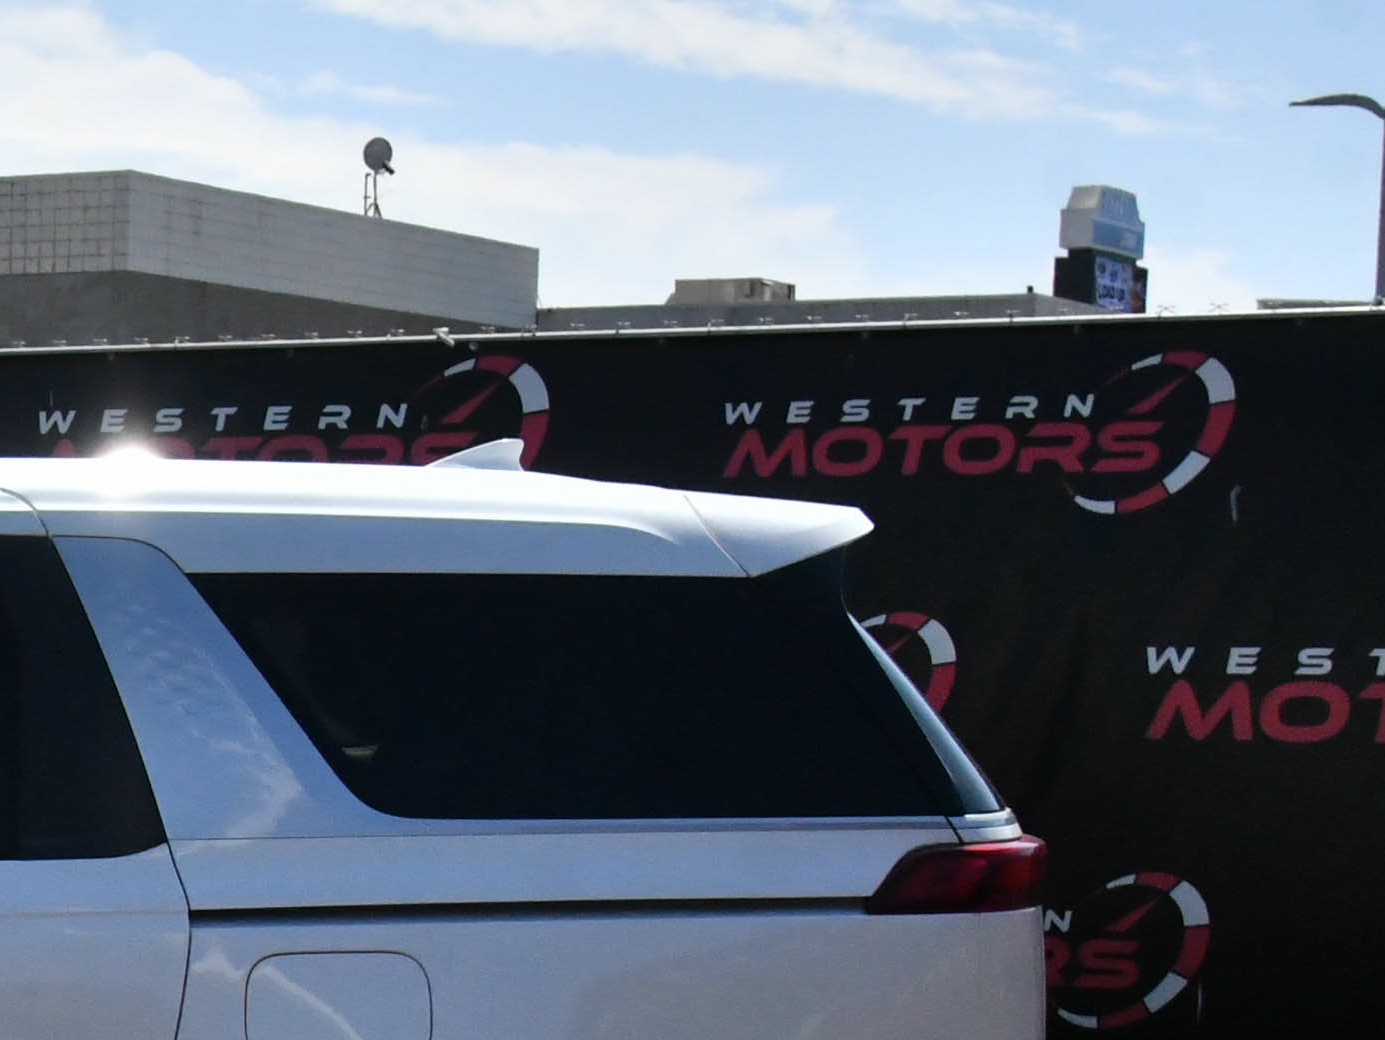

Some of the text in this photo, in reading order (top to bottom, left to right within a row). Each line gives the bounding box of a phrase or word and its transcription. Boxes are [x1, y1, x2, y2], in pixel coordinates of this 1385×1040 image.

[38, 403, 409, 434] WESTERN
[724, 393, 1096, 424] WESTERN
[721, 421, 1165, 478] MOTORS
